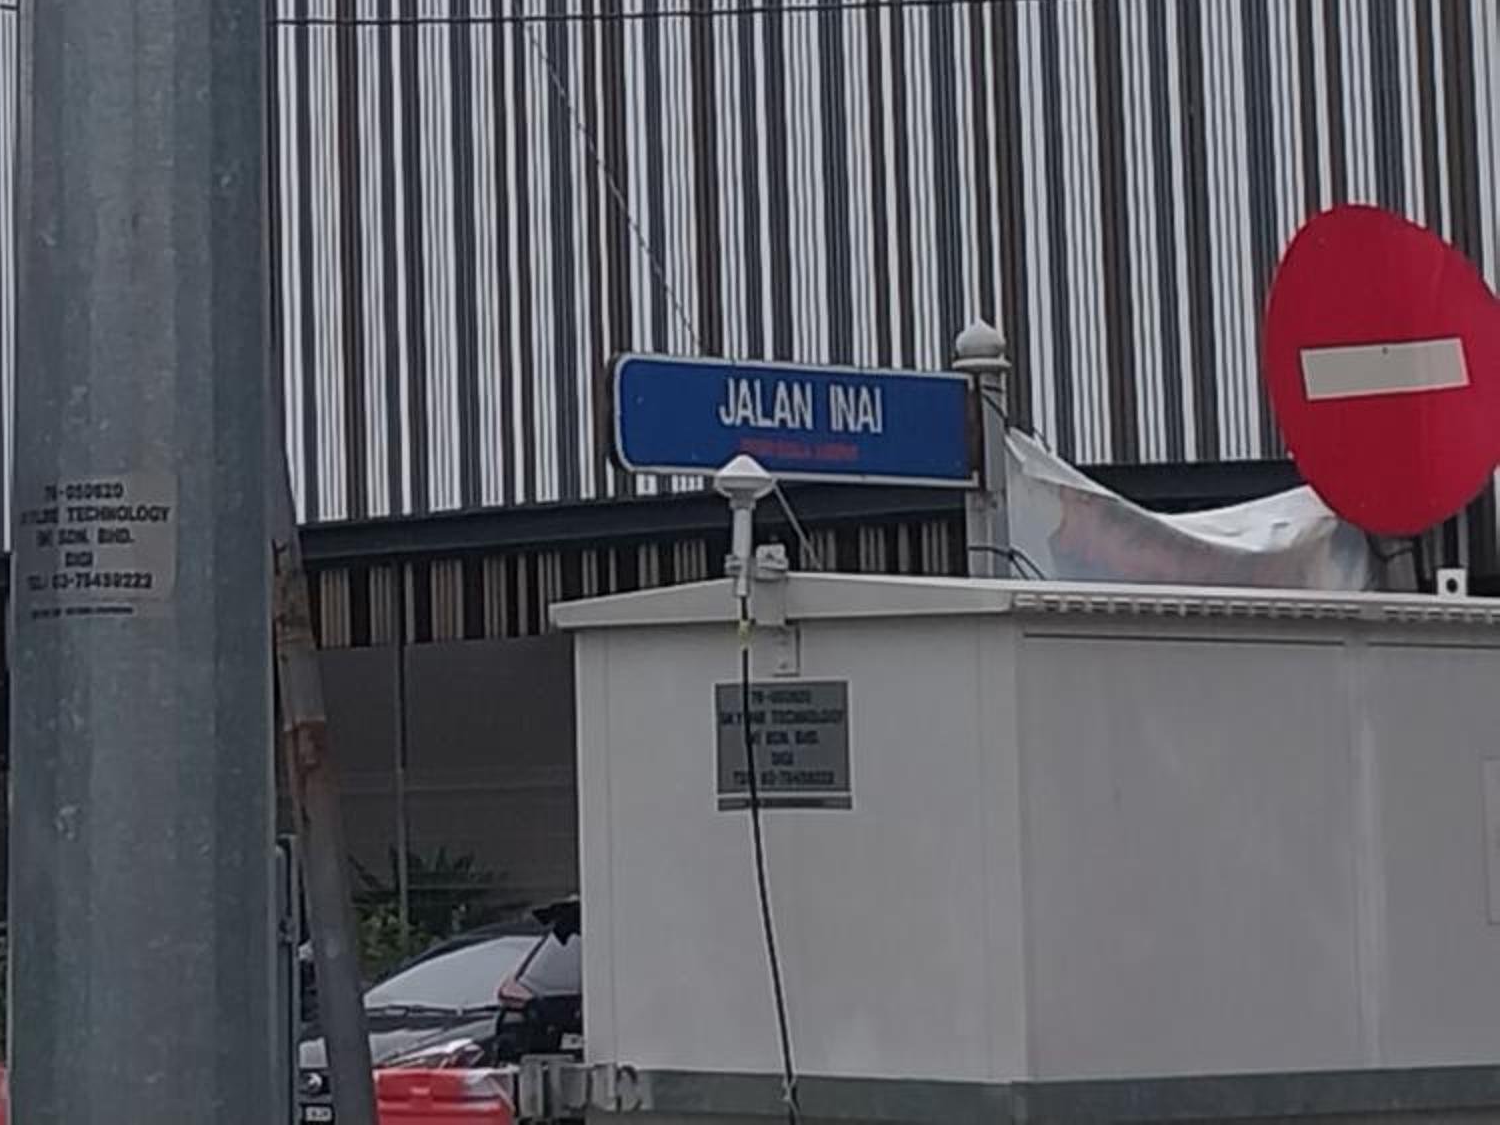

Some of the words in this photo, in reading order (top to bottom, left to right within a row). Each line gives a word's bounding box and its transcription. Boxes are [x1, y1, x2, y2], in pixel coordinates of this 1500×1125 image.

[719, 378, 813, 430] JALAN
[829, 384, 883, 433] INAI
[67, 504, 171, 523] TECHNOLOGY
